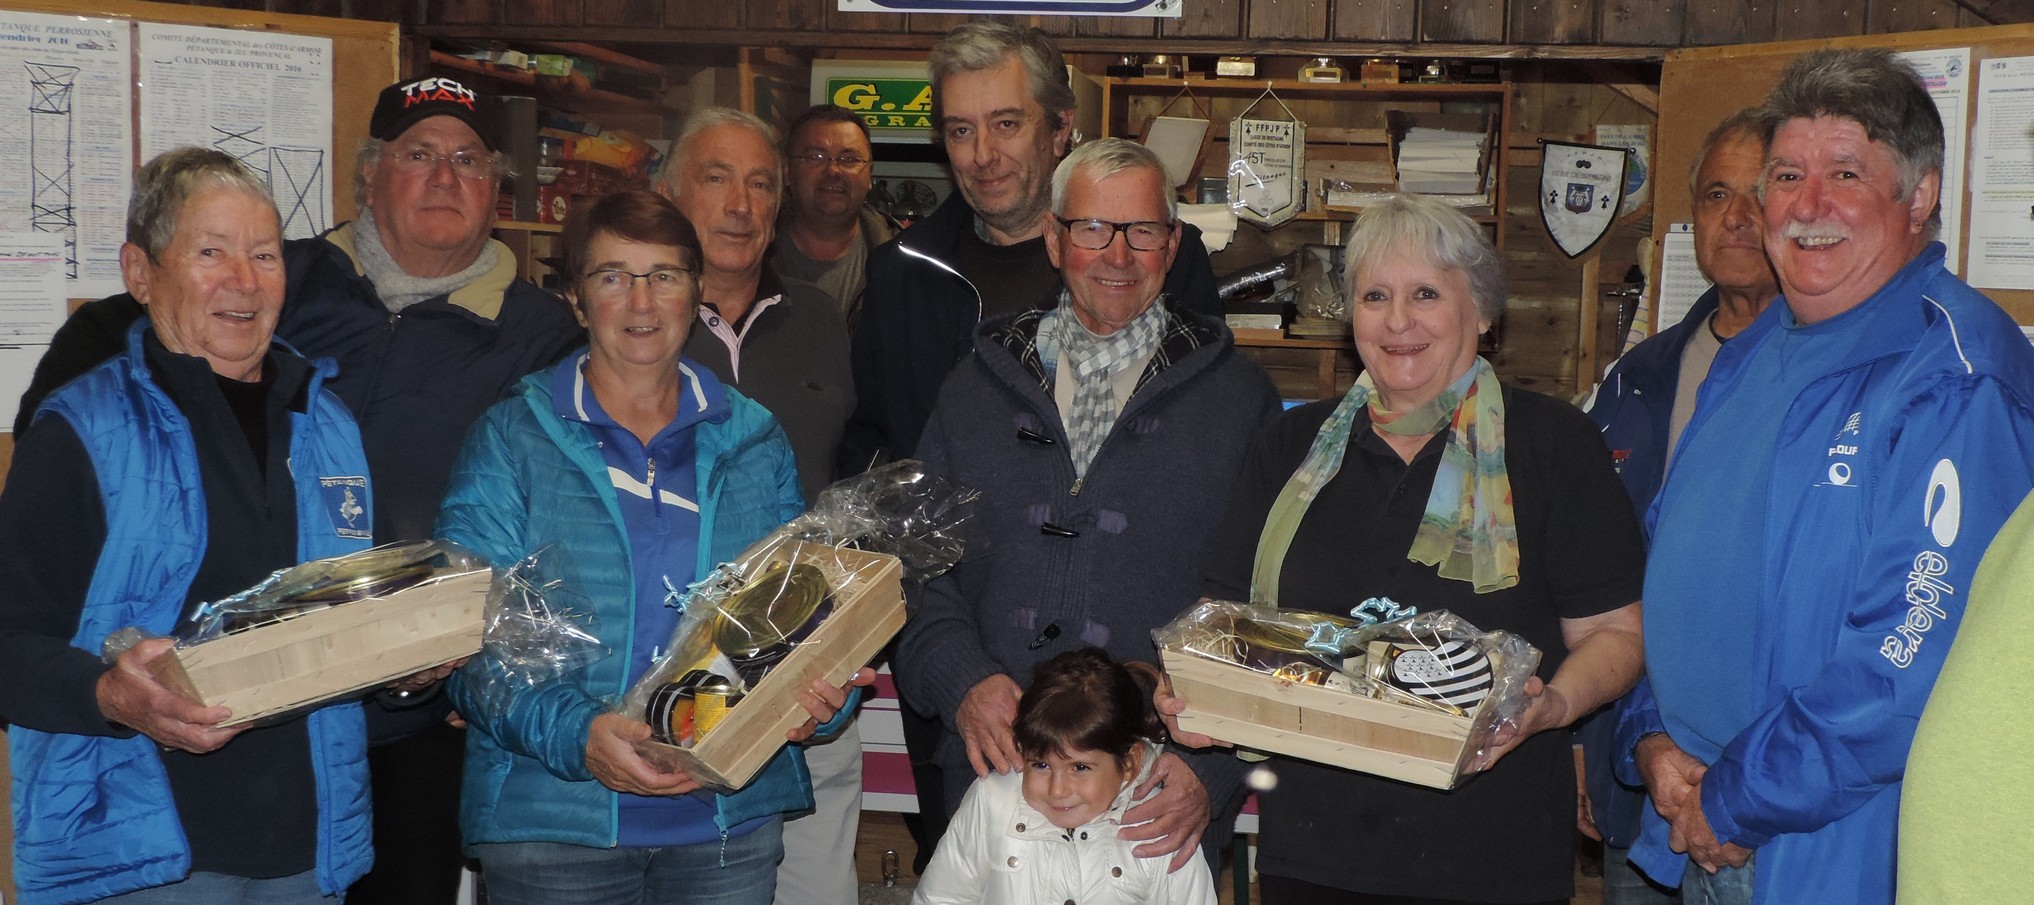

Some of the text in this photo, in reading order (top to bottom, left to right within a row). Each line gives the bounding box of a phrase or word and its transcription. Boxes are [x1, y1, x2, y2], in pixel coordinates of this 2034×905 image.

[174, 56, 302, 73] CALENDRIER OFFICIEL 2016
[401, 77, 475, 102] TECH
[404, 88, 476, 112] MAX
